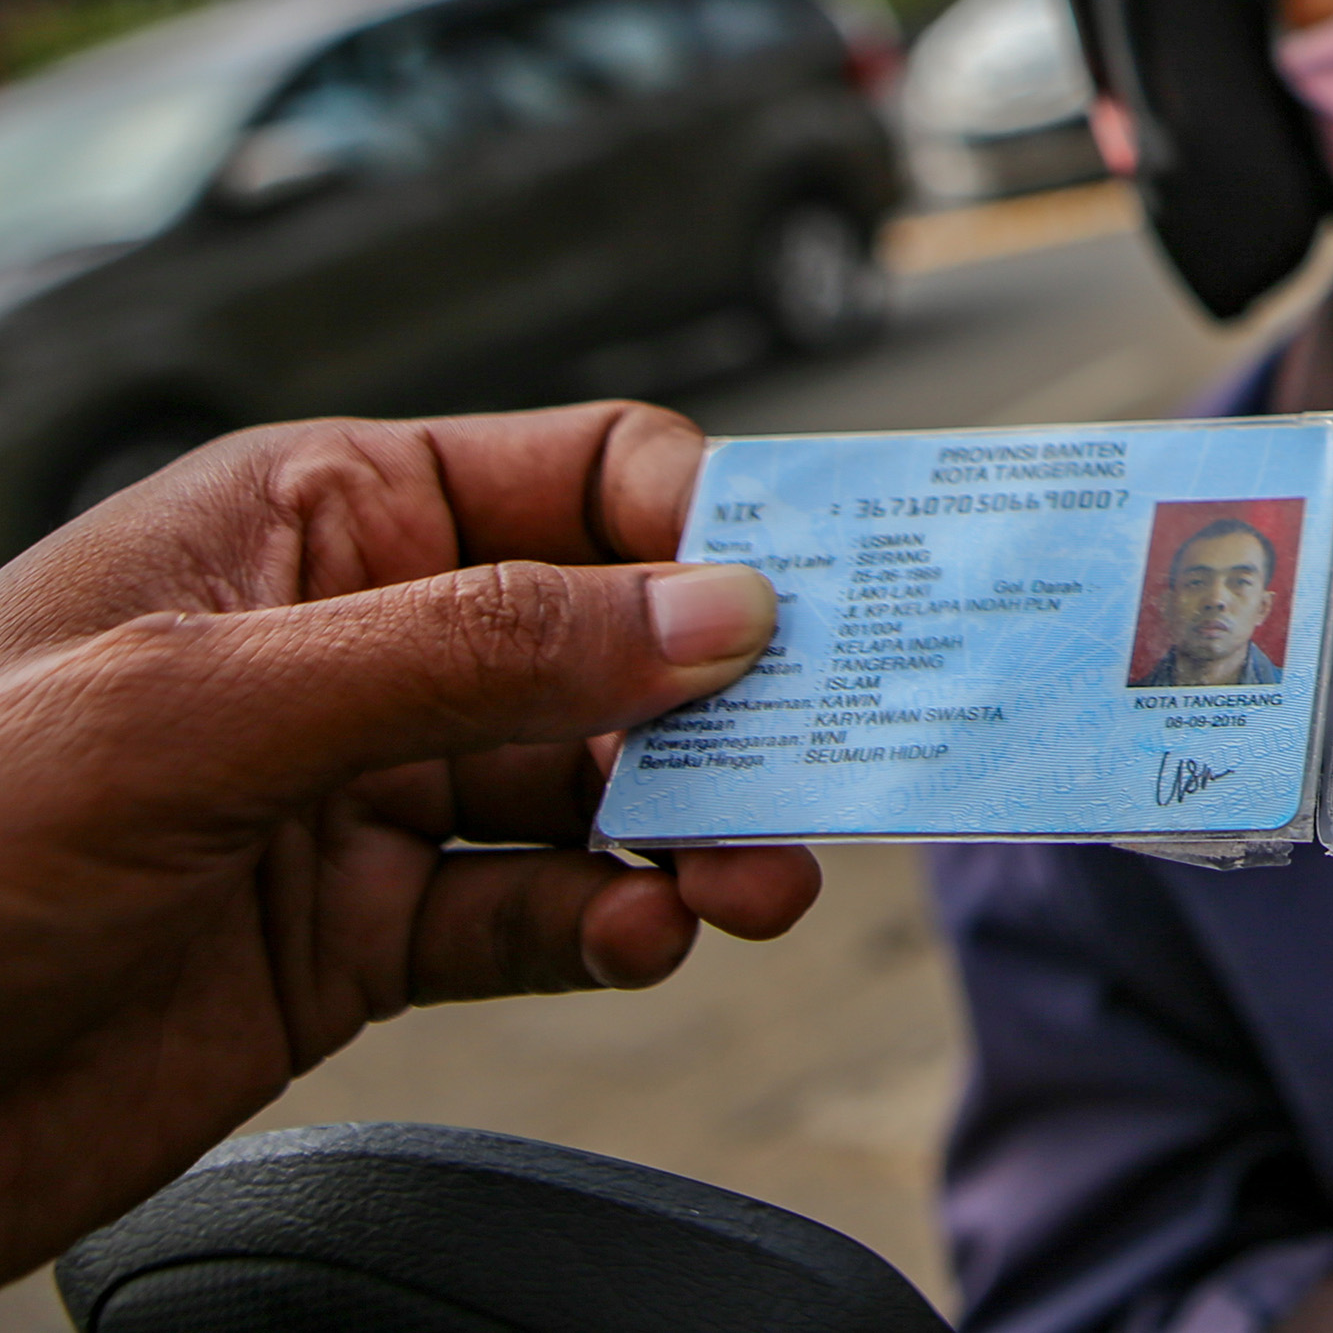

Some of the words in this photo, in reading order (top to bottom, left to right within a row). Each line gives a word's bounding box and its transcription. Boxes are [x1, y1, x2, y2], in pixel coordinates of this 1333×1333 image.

[938, 444, 1039, 463] PROVINSI
[1042, 442, 1127, 459] BANTEN
[931, 467, 988, 484] KOTA
[994, 461, 1125, 480] TANGERANG
[715, 502, 766, 522] NIK
[704, 539, 752, 553] Nama
[860, 533, 926, 549] USMAN
[856, 549, 932, 565] SERANG
[865, 603, 889, 618] KP
[892, 599, 960, 616] KELAPA
[964, 598, 1020, 612] INDAH
[1024, 597, 1062, 611] PLN
[833, 638, 903, 654] KELAPA
[908, 635, 964, 651] INDAH
[830, 654, 944, 672] TANGERANG
[826, 675, 881, 691] ISLAM
[820, 693, 881, 708] KAWIN
[1134, 695, 1178, 709] KOTA
[1184, 693, 1283, 708] TANGERANG
[815, 708, 921, 727] KARYAWAN
[924, 706, 1004, 722] SWASTA
[1166, 714, 1247, 728] 08-09-2016
[810, 730, 847, 745] WNI
[639, 754, 704, 770] Berlaku
[707, 754, 764, 771] Hingga
[804, 747, 885, 764] SEUMUR
[890, 744, 948, 760] HIDUP
